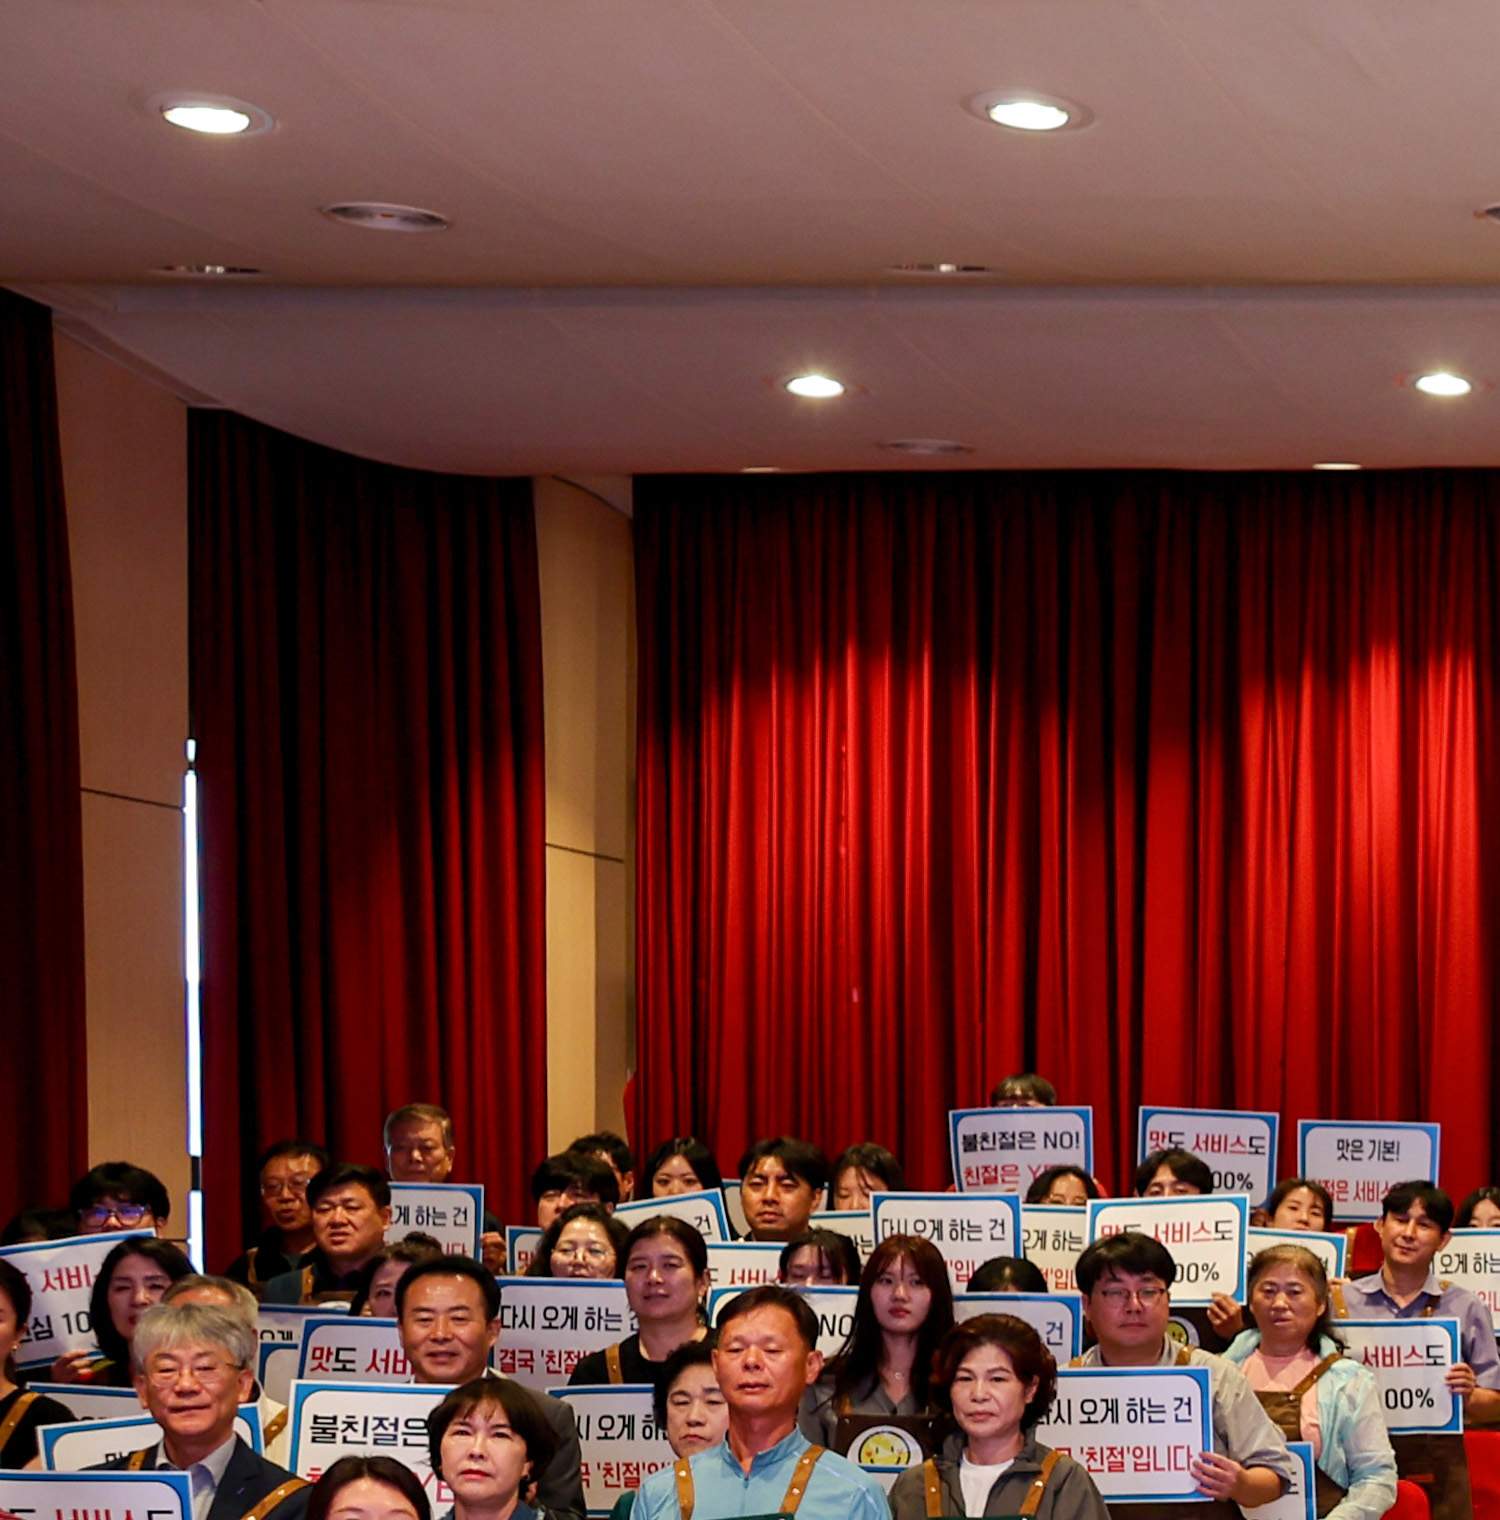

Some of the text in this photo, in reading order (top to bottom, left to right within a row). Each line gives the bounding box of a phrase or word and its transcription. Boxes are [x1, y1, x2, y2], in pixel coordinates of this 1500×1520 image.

[962, 1131, 1079, 1153] 불친절은 NO!
[1149, 1130, 1265, 1155] 맛도 서비스도
[1337, 1139, 1400, 1162] 맛은 기본!
[964, 1164, 1019, 1187] 친절은
[416, 1206, 467, 1227] 하는 건
[949, 1219, 1005, 1241] 하는 건
[1052, 1230, 1083, 1252] 하는
[1153, 1220, 1234, 1244] 서비스도
[1440, 1253, 1467, 1274] 오게
[500, 1304, 622, 1331] 다시 오게 하는
[1046, 1322, 1063, 1346] 건
[310, 1347, 356, 1372] 맛도
[499, 1349, 534, 1374] 결국
[1360, 1345, 1445, 1368] 서비스도
[1080, 1397, 1192, 1424] 오게 하는 건
[309, 1415, 430, 1446] 불친절은
[597, 1415, 635, 1440] 오게
[1080, 1445, 1193, 1473] '친절'입니다
